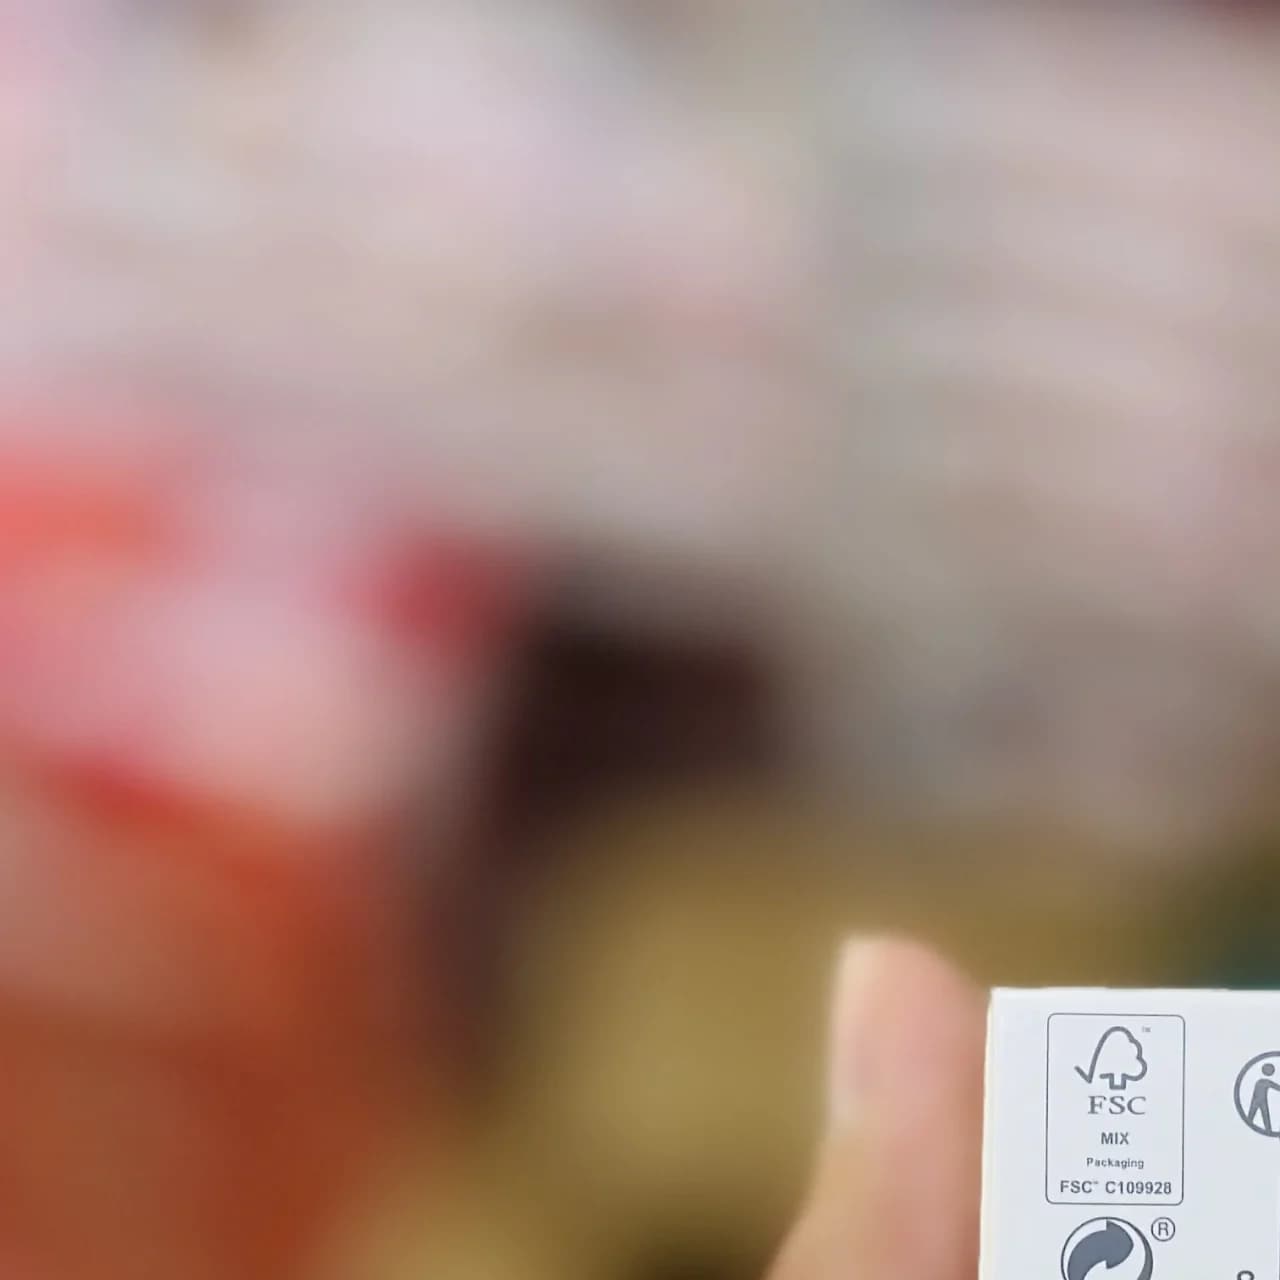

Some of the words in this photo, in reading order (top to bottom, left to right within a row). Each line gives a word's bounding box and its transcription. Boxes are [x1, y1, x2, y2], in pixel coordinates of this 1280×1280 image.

[1087, 1095, 1147, 1115] FSC
[1100, 1132, 1130, 1145] MIX
[1086, 1157, 1145, 1170] Packaging
[1105, 1181, 1172, 1195] C109928
